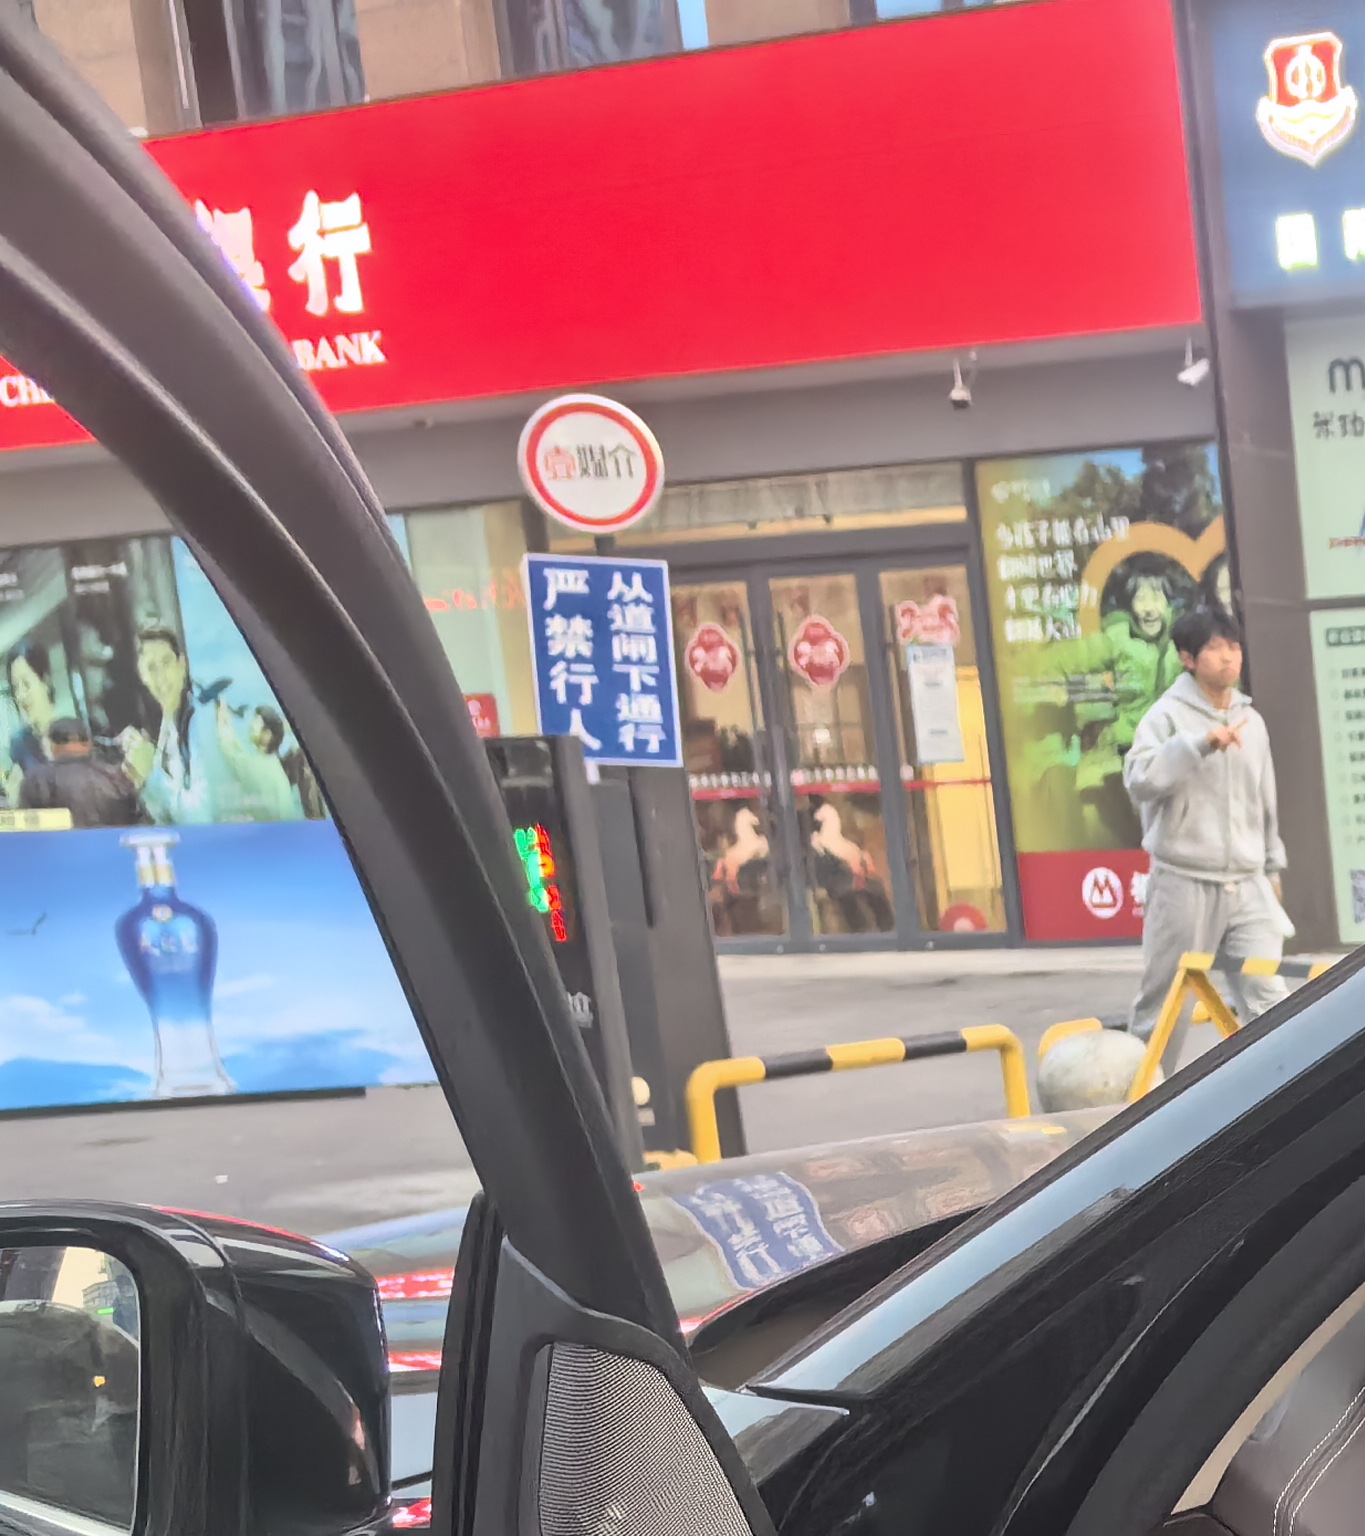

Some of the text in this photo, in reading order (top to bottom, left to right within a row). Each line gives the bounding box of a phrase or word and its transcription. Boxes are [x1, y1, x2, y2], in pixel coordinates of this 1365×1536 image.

[291, 330, 387, 371] BANK
[543, 567, 602, 751] 严禁行人
